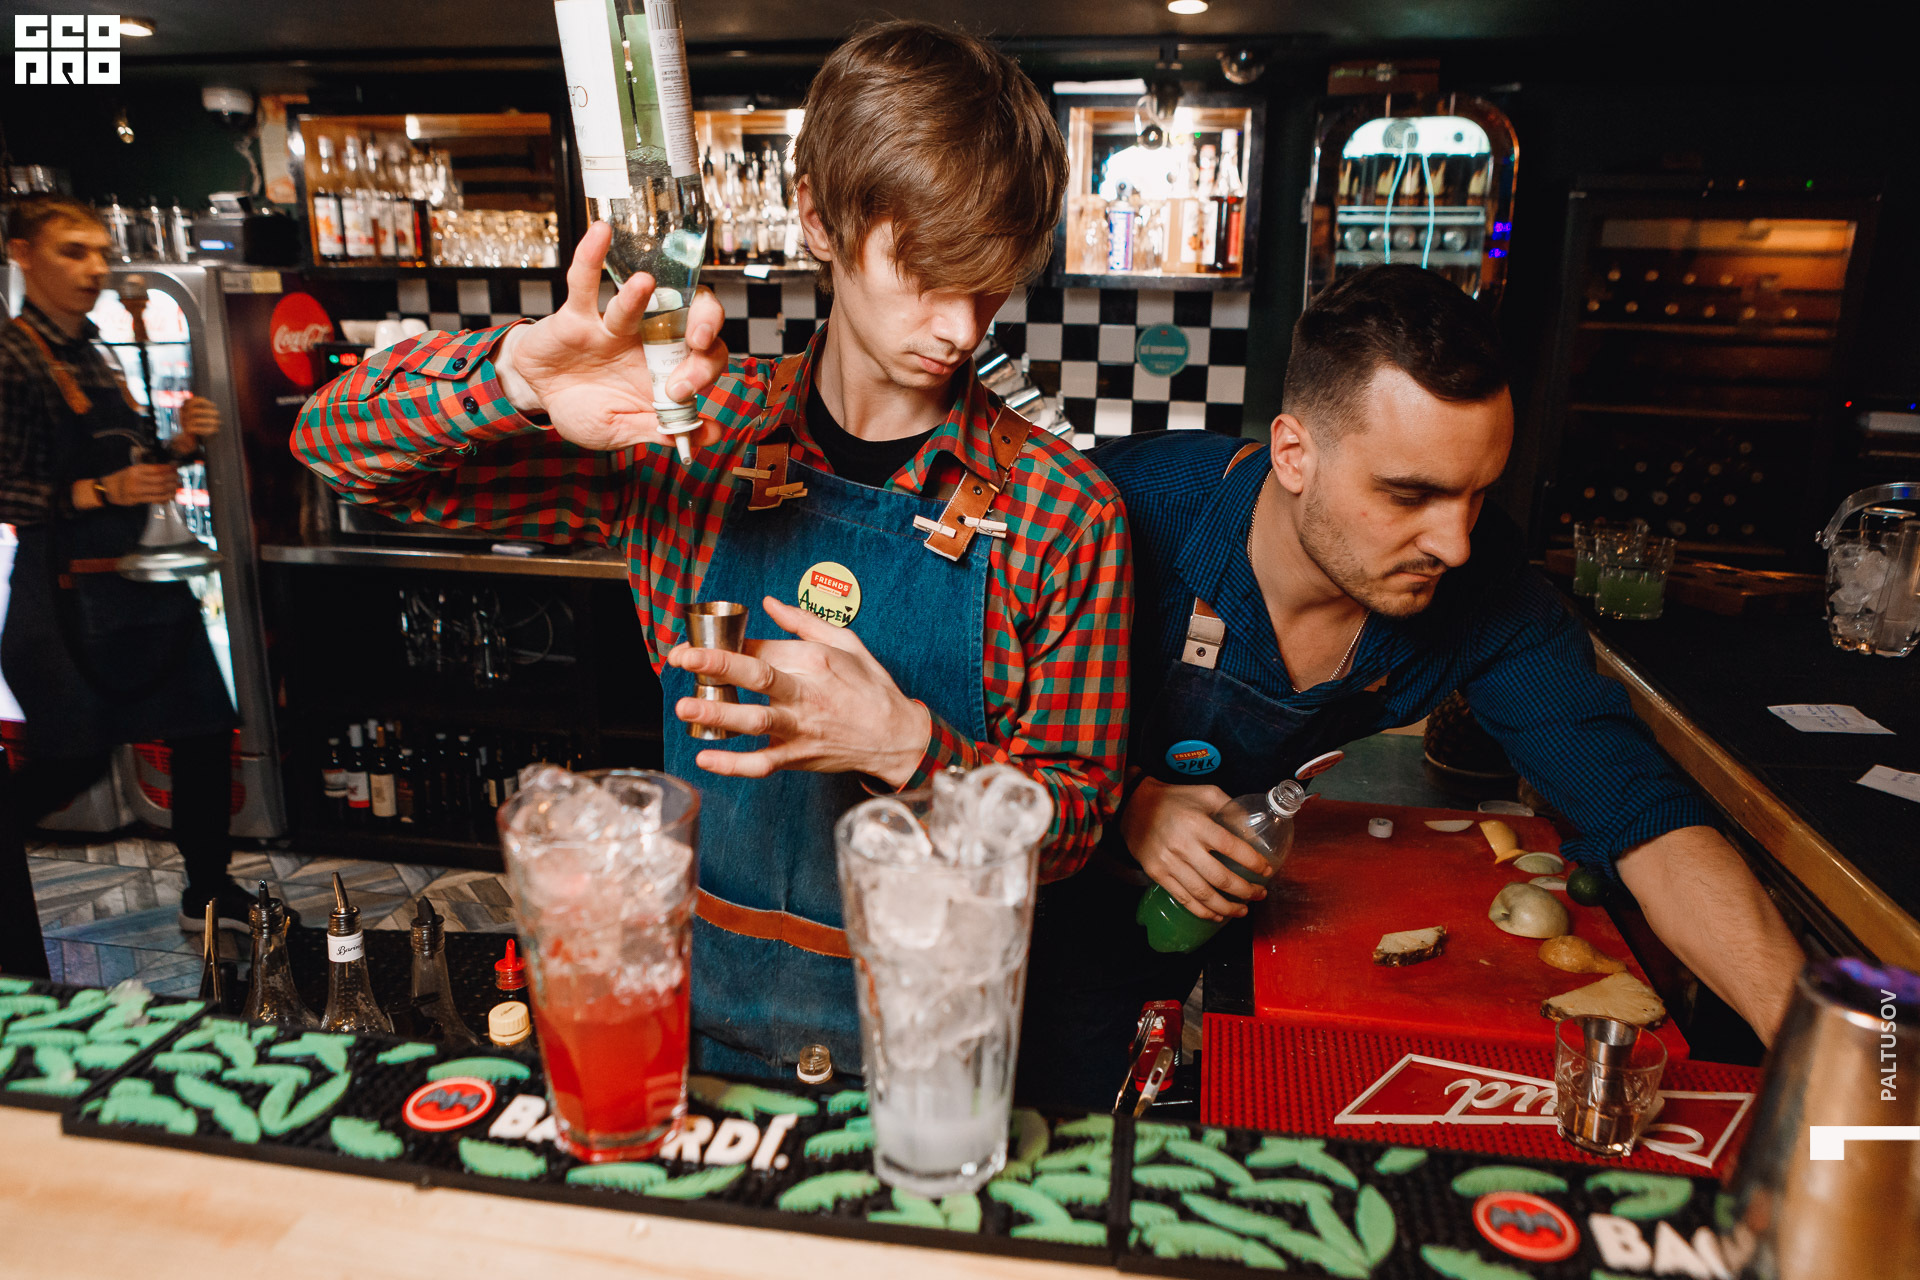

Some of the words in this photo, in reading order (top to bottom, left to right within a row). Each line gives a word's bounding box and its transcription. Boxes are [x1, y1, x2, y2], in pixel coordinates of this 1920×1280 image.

[813, 574, 850, 592] FRIENDS
[1175, 749, 1208, 759] FRIENDS
[488, 1093, 798, 1171] BARDI.
